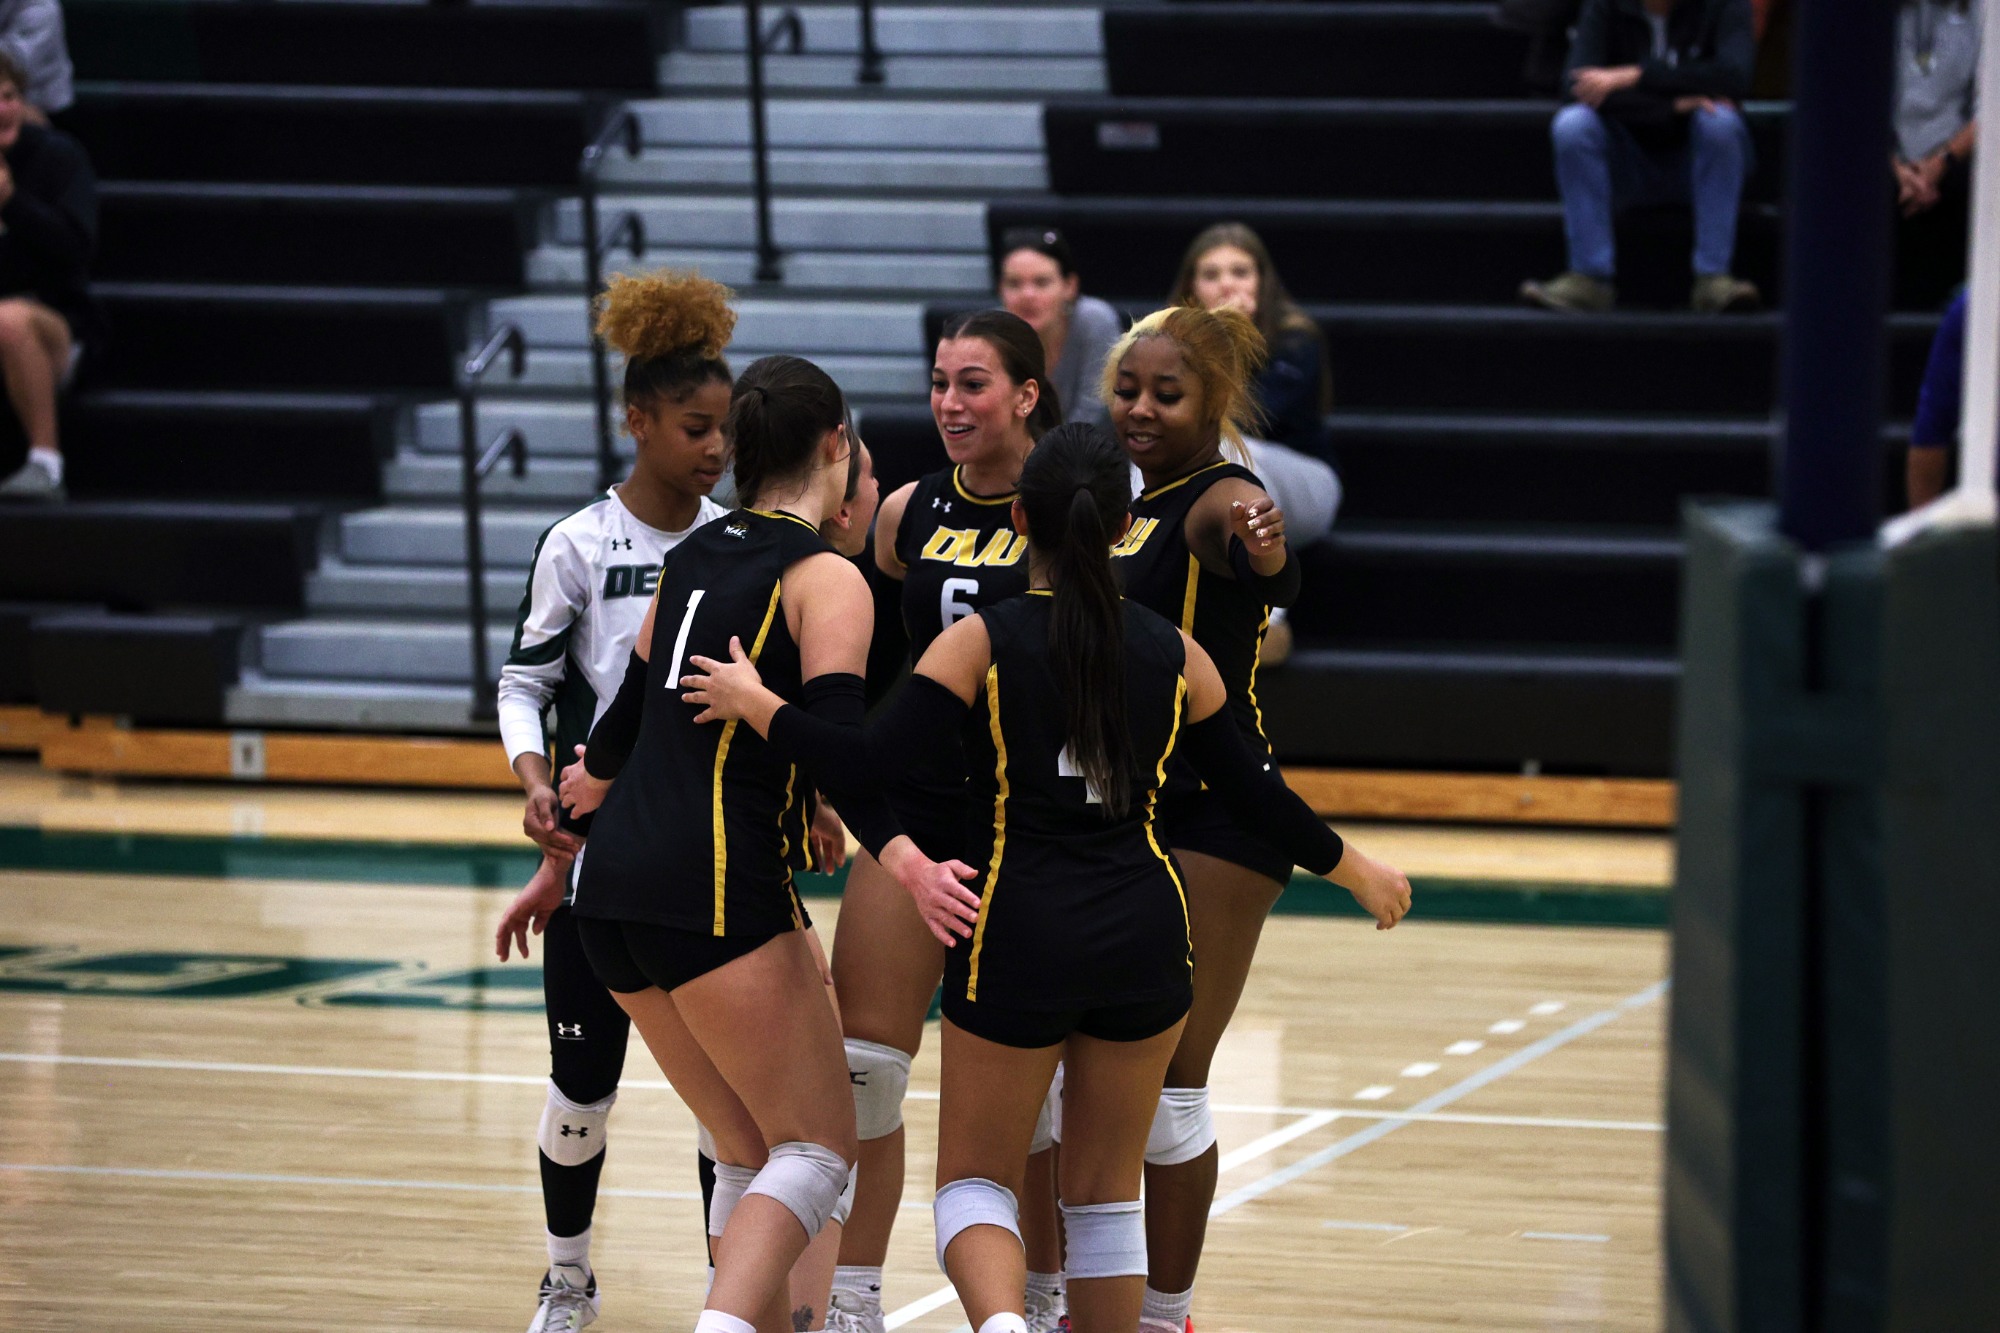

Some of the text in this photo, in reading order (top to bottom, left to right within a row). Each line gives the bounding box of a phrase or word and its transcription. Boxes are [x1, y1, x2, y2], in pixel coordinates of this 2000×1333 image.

[723, 525, 747, 537] MAC
[940, 577, 980, 631] 6
[664, 589, 706, 690] 1
